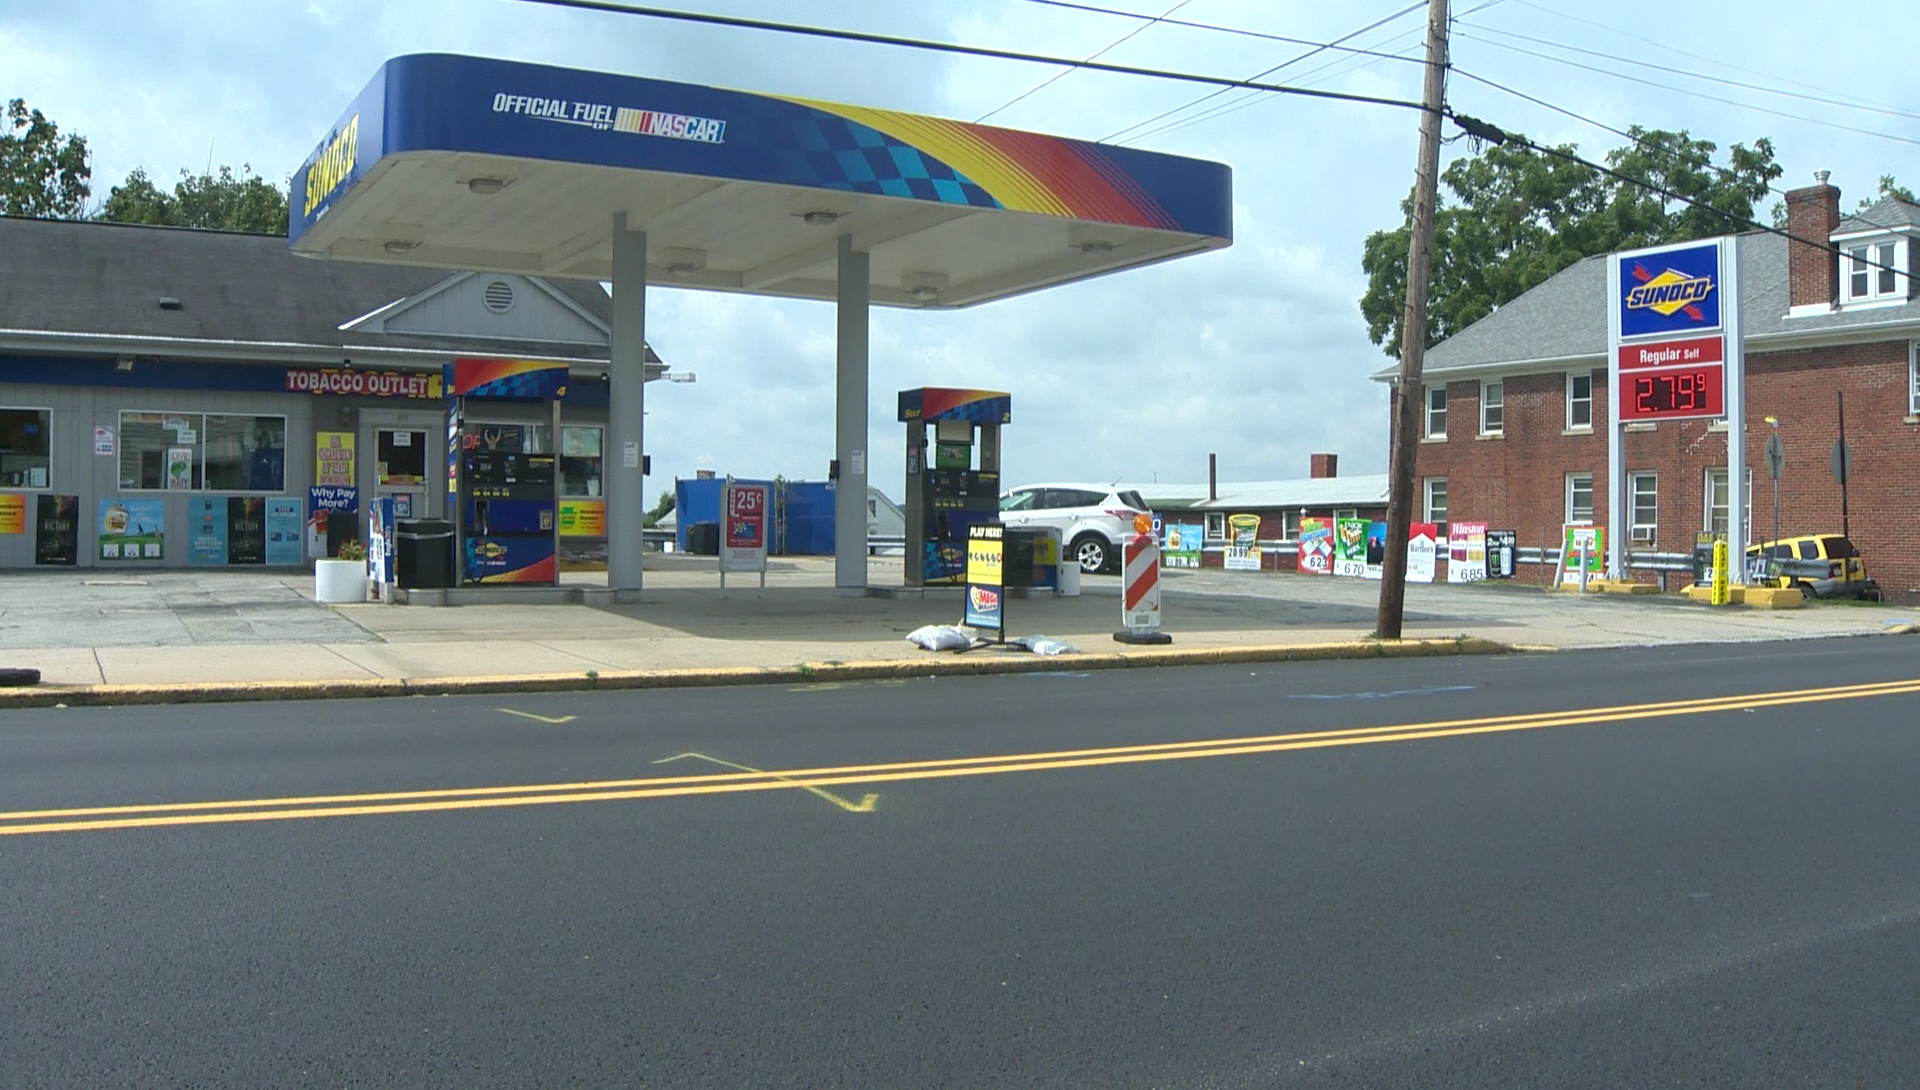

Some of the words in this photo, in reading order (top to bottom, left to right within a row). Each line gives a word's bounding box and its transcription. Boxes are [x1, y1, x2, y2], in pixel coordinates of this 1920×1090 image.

[493, 93, 568, 118] OFFICIAL
[572, 102, 614, 123] FUEL
[651, 112, 720, 142] NASCAR
[304, 114, 359, 218] SUNOCO
[1630, 280, 1709, 307] SUNOCO
[1640, 348, 1681, 365] Regular
[1684, 348, 1700, 359] Self
[287, 371, 363, 392] TOBACCO
[367, 375, 427, 394] OUTLET
[556, 386, 567, 397] 4
[311, 488, 336, 498] Why
[337, 489, 356, 500] Pay
[318, 499, 349, 508] More?
[1452, 523, 1485, 534] Winston
[1410, 543, 1434, 553] Marlboro
